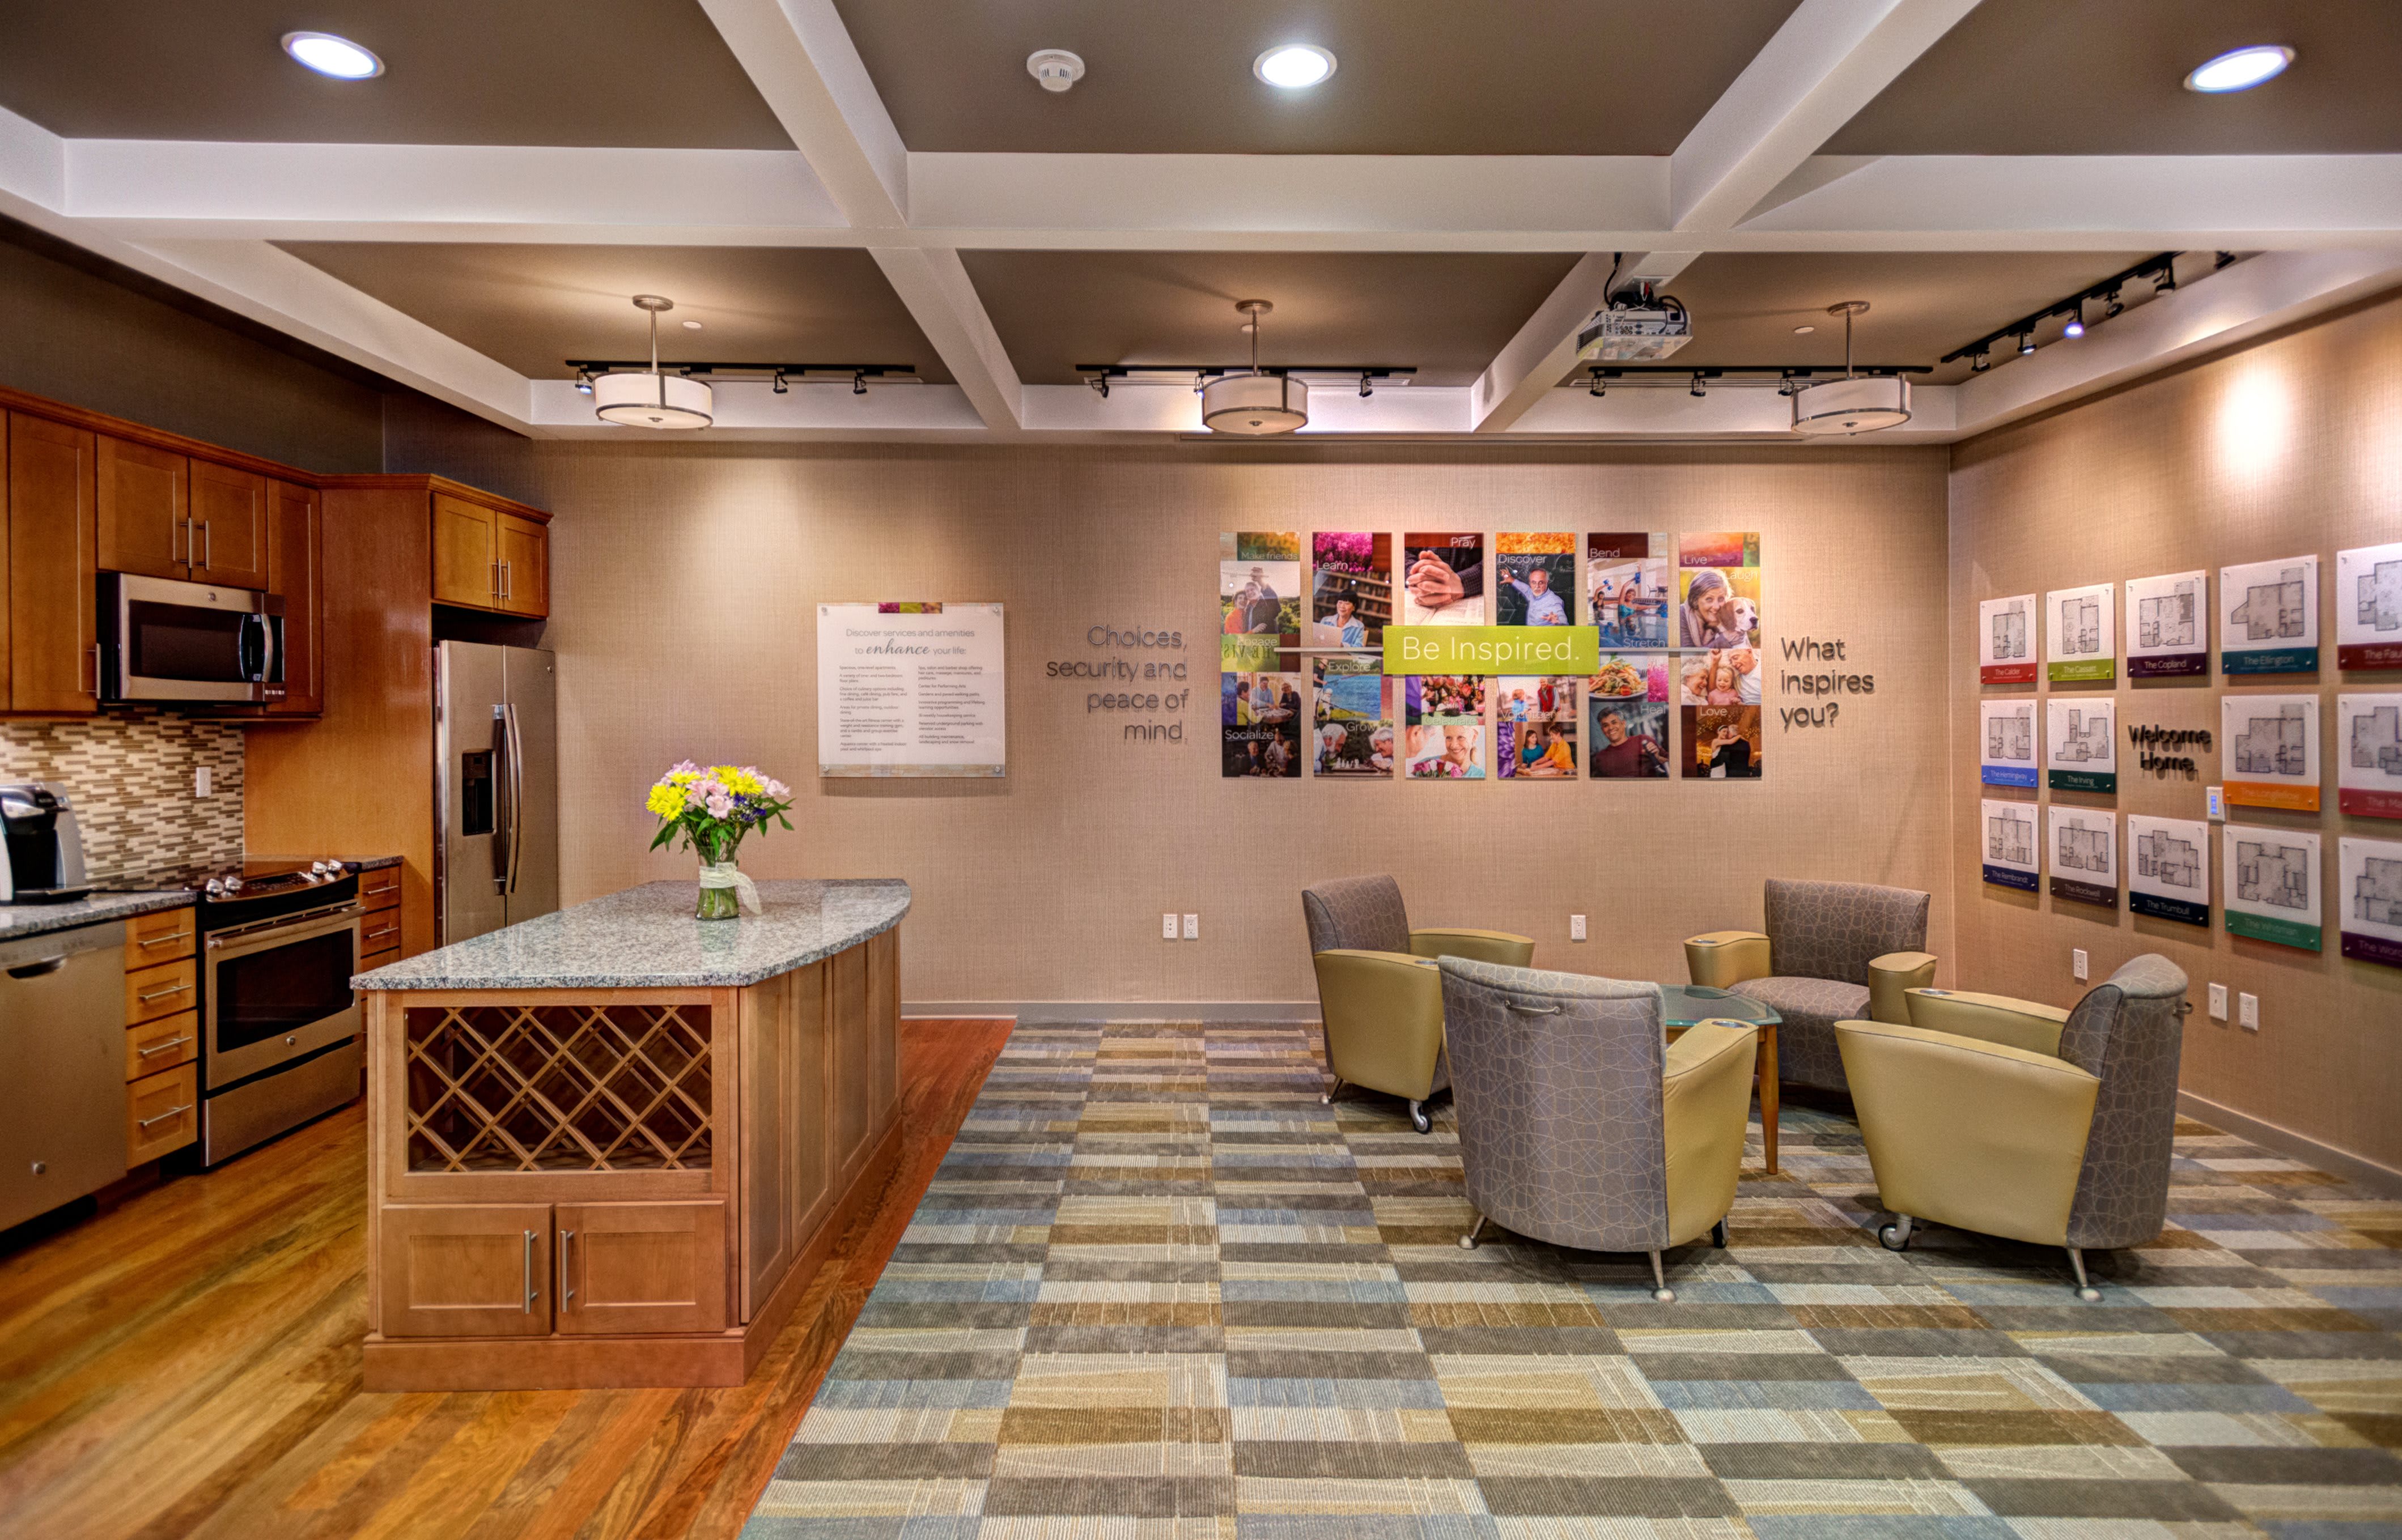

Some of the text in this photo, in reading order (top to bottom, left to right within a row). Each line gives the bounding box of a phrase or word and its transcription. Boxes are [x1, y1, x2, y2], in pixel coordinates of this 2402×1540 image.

[1450, 537, 1476, 550] Pray
[1266, 551, 1298, 560] friends
[1590, 548, 1620, 558] Bend
[1498, 554, 1547, 564] Discover
[1684, 555, 1708, 564] Live
[1317, 560, 1348, 571] Learn
[1726, 570, 1758, 581] Laugh
[1088, 624, 1187, 652] Choices,
[1623, 638, 1666, 648] Stretch
[866, 638, 931, 655] enhance
[932, 648, 950, 656] your
[1403, 636, 1580, 666] Be Inspired.
[1781, 636, 1847, 661] What
[2363, 649, 2383, 660] The
[2158, 659, 2187, 670] Copland
[2243, 655, 2295, 666] The Ellington
[1046, 656, 1187, 682] security and
[1329, 662, 1371, 673] Explore
[1781, 669, 1875, 700] inspires
[1088, 688, 1190, 713] peace of
[1500, 710, 1555, 719] Volunteer
[1640, 705, 1666, 714] Heal
[1700, 707, 1728, 716] Love
[1425, 716, 1476, 725] Celebrate
[1780, 702, 1839, 733] you?
[1124, 719, 1188, 741] mind.
[1346, 722, 1377, 732] Grow
[1225, 730, 1274, 740] Socialize
[2128, 724, 2212, 747] Welcome
[2140, 751, 2199, 773] Home.
[2079, 777, 2094, 786] Irving
[2367, 796, 2385, 807] The
[2001, 871, 2028, 884] Rembrandt
[2065, 884, 2075, 892] The
[2076, 886, 2100, 898] Rockwell
[2146, 900, 2159, 909] The
[2160, 902, 2190, 915] Trumbull
[2358, 940, 2376, 952] The
